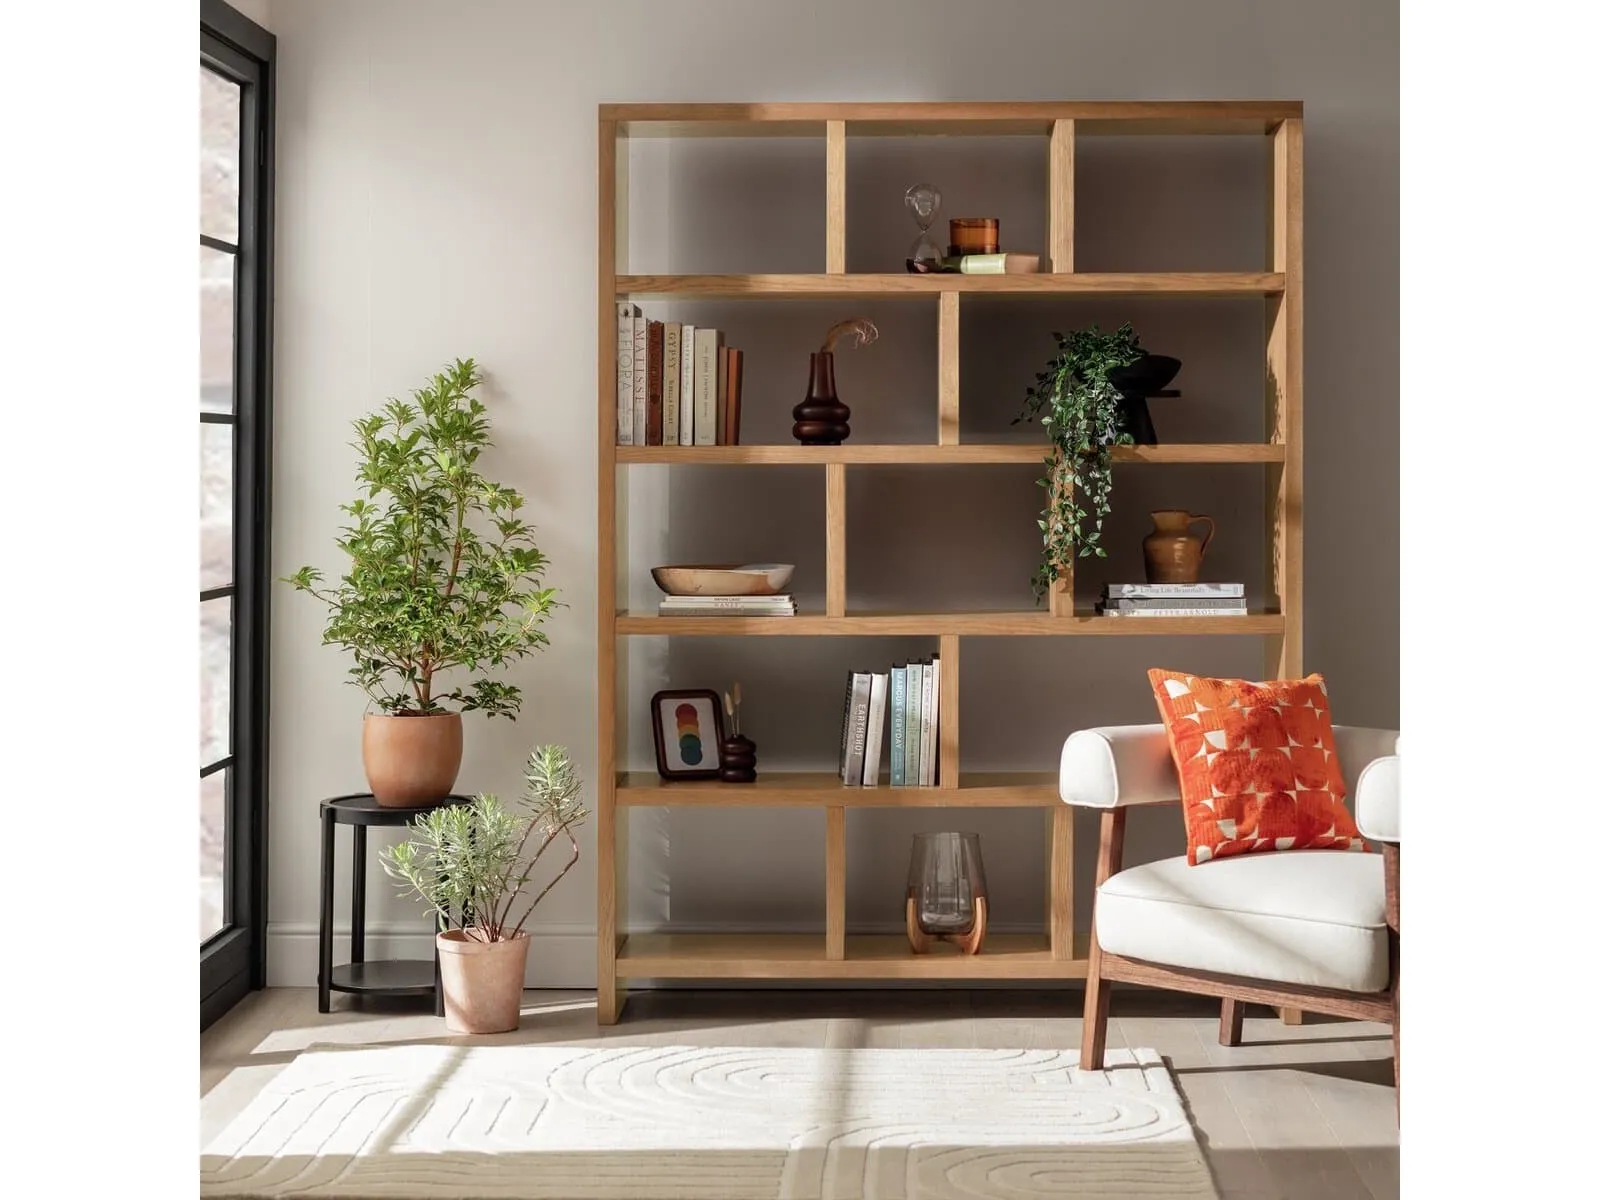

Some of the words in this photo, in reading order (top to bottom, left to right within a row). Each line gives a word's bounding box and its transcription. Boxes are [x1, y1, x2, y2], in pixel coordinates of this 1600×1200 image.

[635, 329, 645, 404] MATISSE
[668, 332, 677, 369] GYPSY
[855, 703, 866, 755] EARTHSHOT
[895, 708, 903, 750] EVERYDAY
